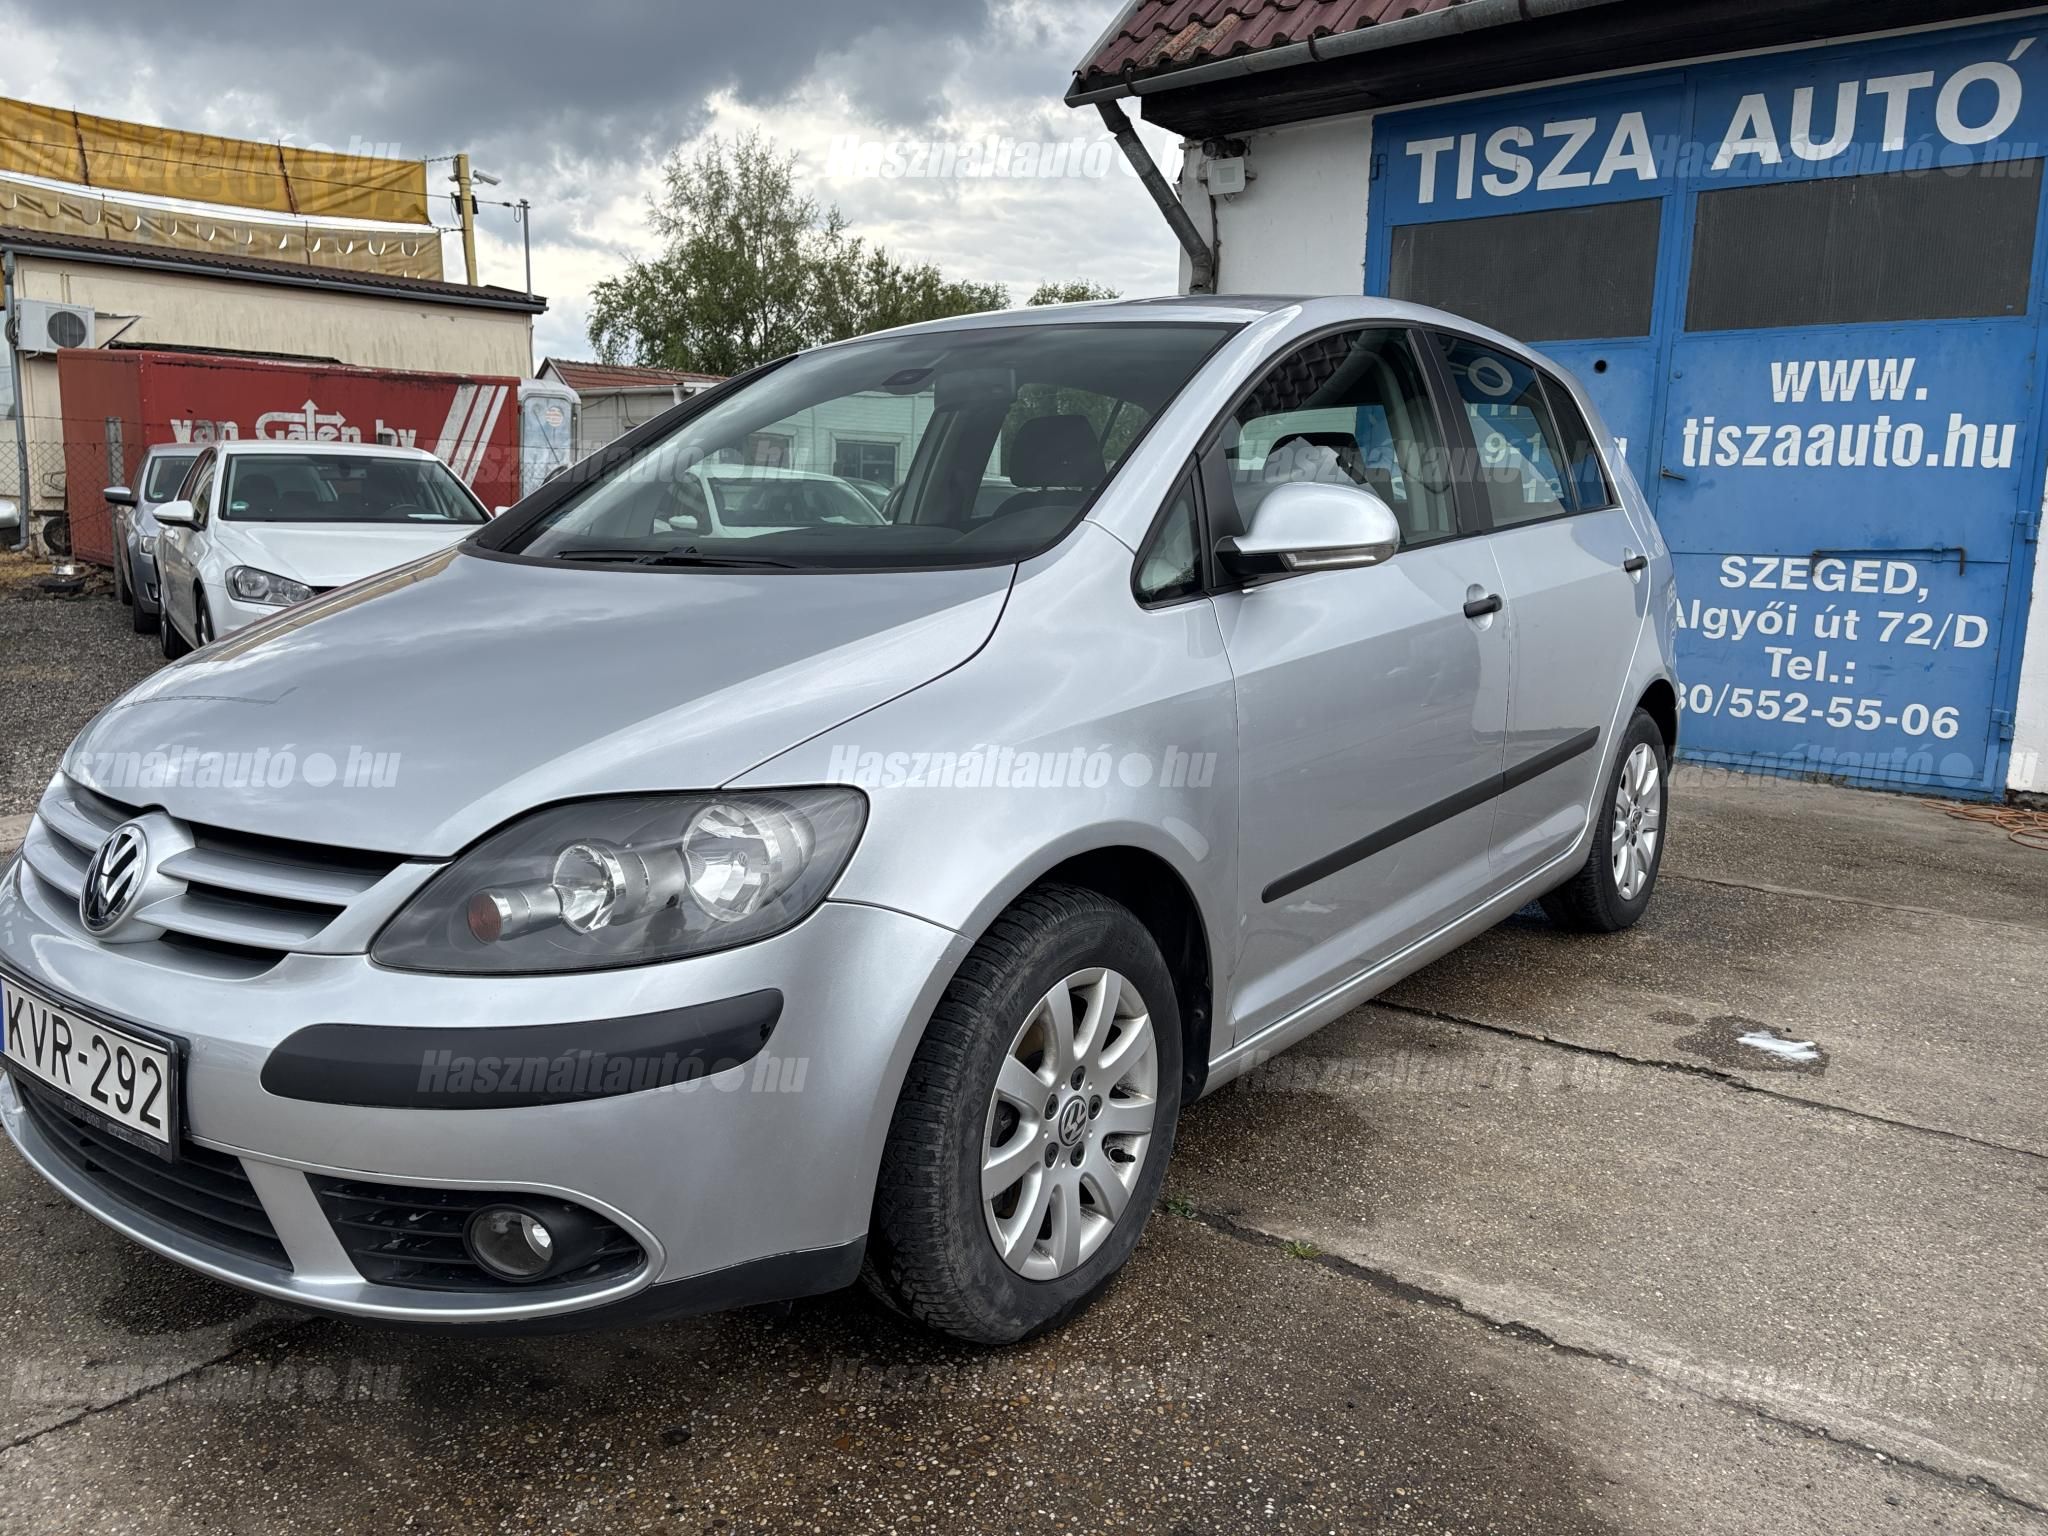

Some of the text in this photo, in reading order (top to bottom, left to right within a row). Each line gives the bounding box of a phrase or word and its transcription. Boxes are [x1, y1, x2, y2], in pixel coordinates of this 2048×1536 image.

[1405, 36, 2038, 204] TISZA AUTÓ
[1770, 357, 1928, 403] www.
[170, 418, 239, 444] van
[1681, 412, 2017, 469] tiszaauto.hu
[1718, 555, 1930, 604] SZEGED,
[1814, 604, 1858, 643] út
[1877, 609, 1990, 650] 72/D
[1764, 646, 1857, 685] Tel.:
[7, 990, 162, 1130] KVR-292
